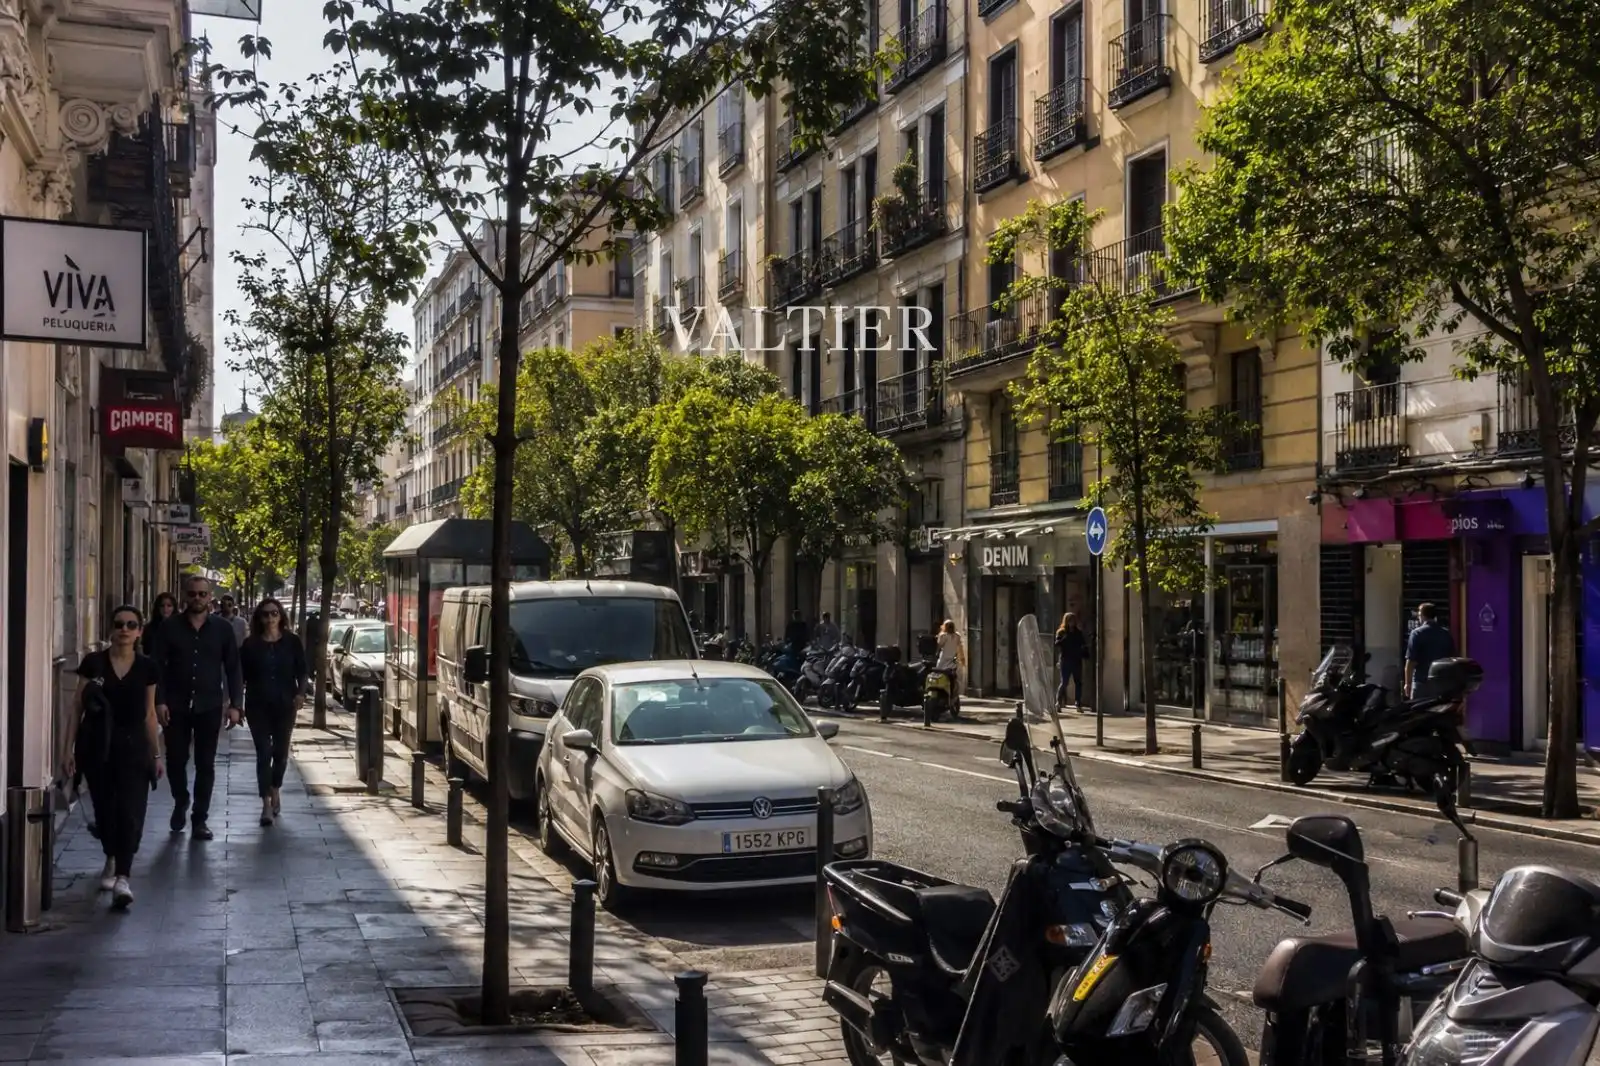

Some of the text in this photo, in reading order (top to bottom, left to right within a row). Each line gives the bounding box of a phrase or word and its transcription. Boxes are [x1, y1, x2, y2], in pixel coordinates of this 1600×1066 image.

[110, 410, 174, 434] CAMPER
[983, 545, 1029, 566] DENIM
[735, 830, 804, 849] 1552 KPG
